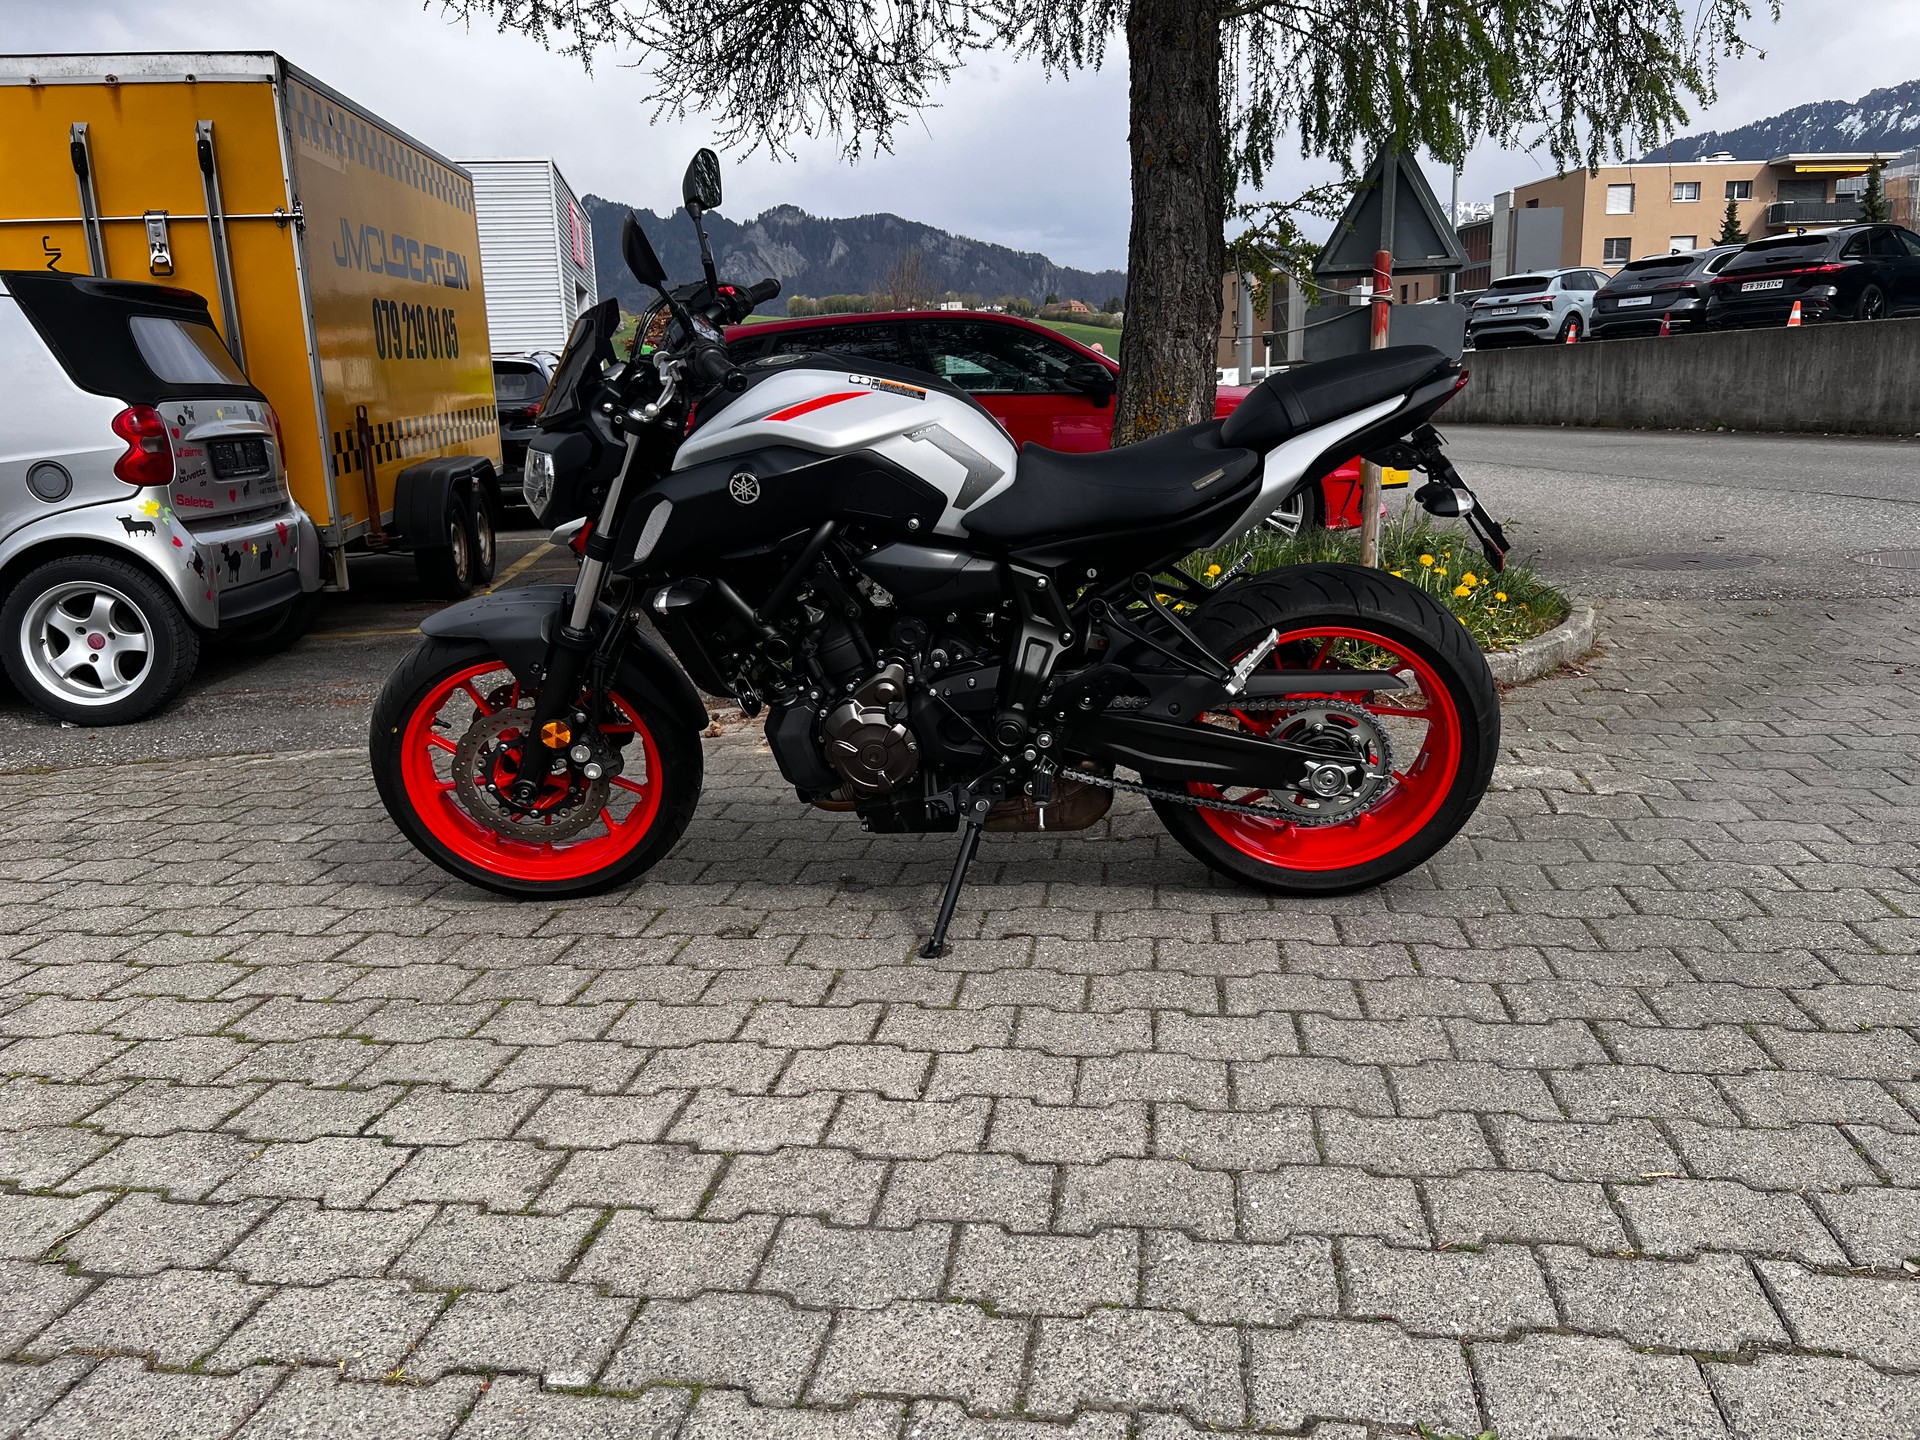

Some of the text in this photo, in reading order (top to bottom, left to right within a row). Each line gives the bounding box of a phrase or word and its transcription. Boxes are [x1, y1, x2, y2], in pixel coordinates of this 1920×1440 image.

[372, 298, 459, 360] 079 219 01 85
[176, 447, 203, 458] J'aime
[179, 468, 207, 483] buvette
[176, 494, 214, 509] Saletta
